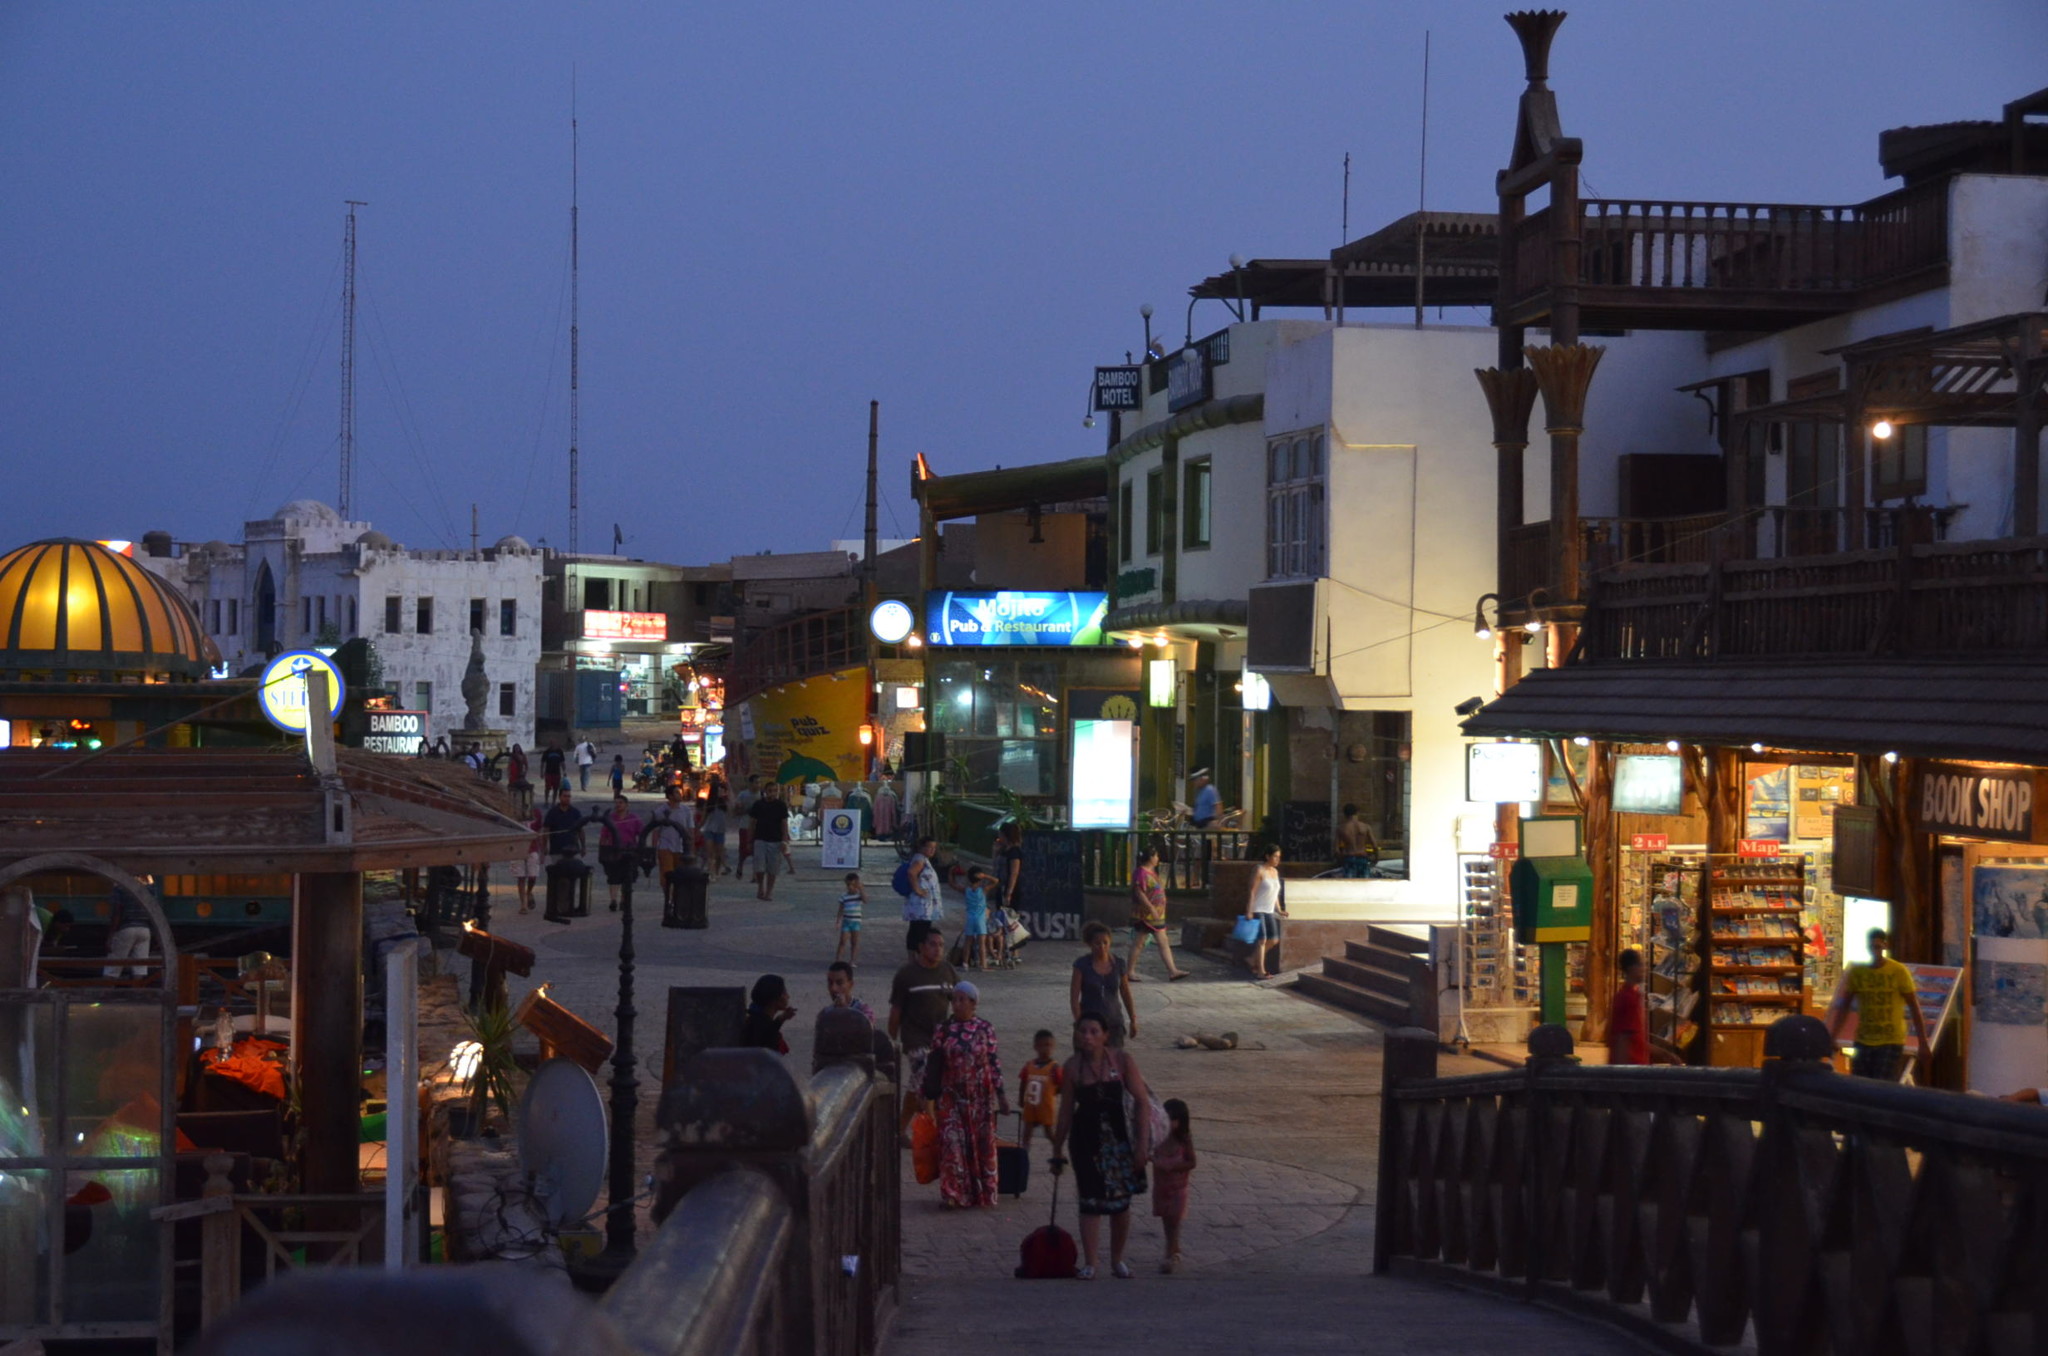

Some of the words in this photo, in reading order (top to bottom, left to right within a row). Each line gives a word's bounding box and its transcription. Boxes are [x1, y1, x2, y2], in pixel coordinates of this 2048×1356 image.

[1098, 371, 1138, 386] BAMBOO
[1102, 388, 1134, 405] HOTEL
[978, 599, 1045, 620] Mojito
[950, 619, 978, 633] Pub
[981, 621, 991, 633] &
[994, 619, 1071, 633] Restaurant
[371, 715, 418, 732] BAMBOO
[363, 736, 423, 754] RESTAURANT
[1922, 773, 1974, 827] BOOK
[1977, 777, 2031, 832] SHOP
[1490, 844, 1500, 856] 2
[1634, 836, 1643, 848] 2
[1740, 841, 1778, 856] Map
[1025, 1080, 1042, 1106] 9
